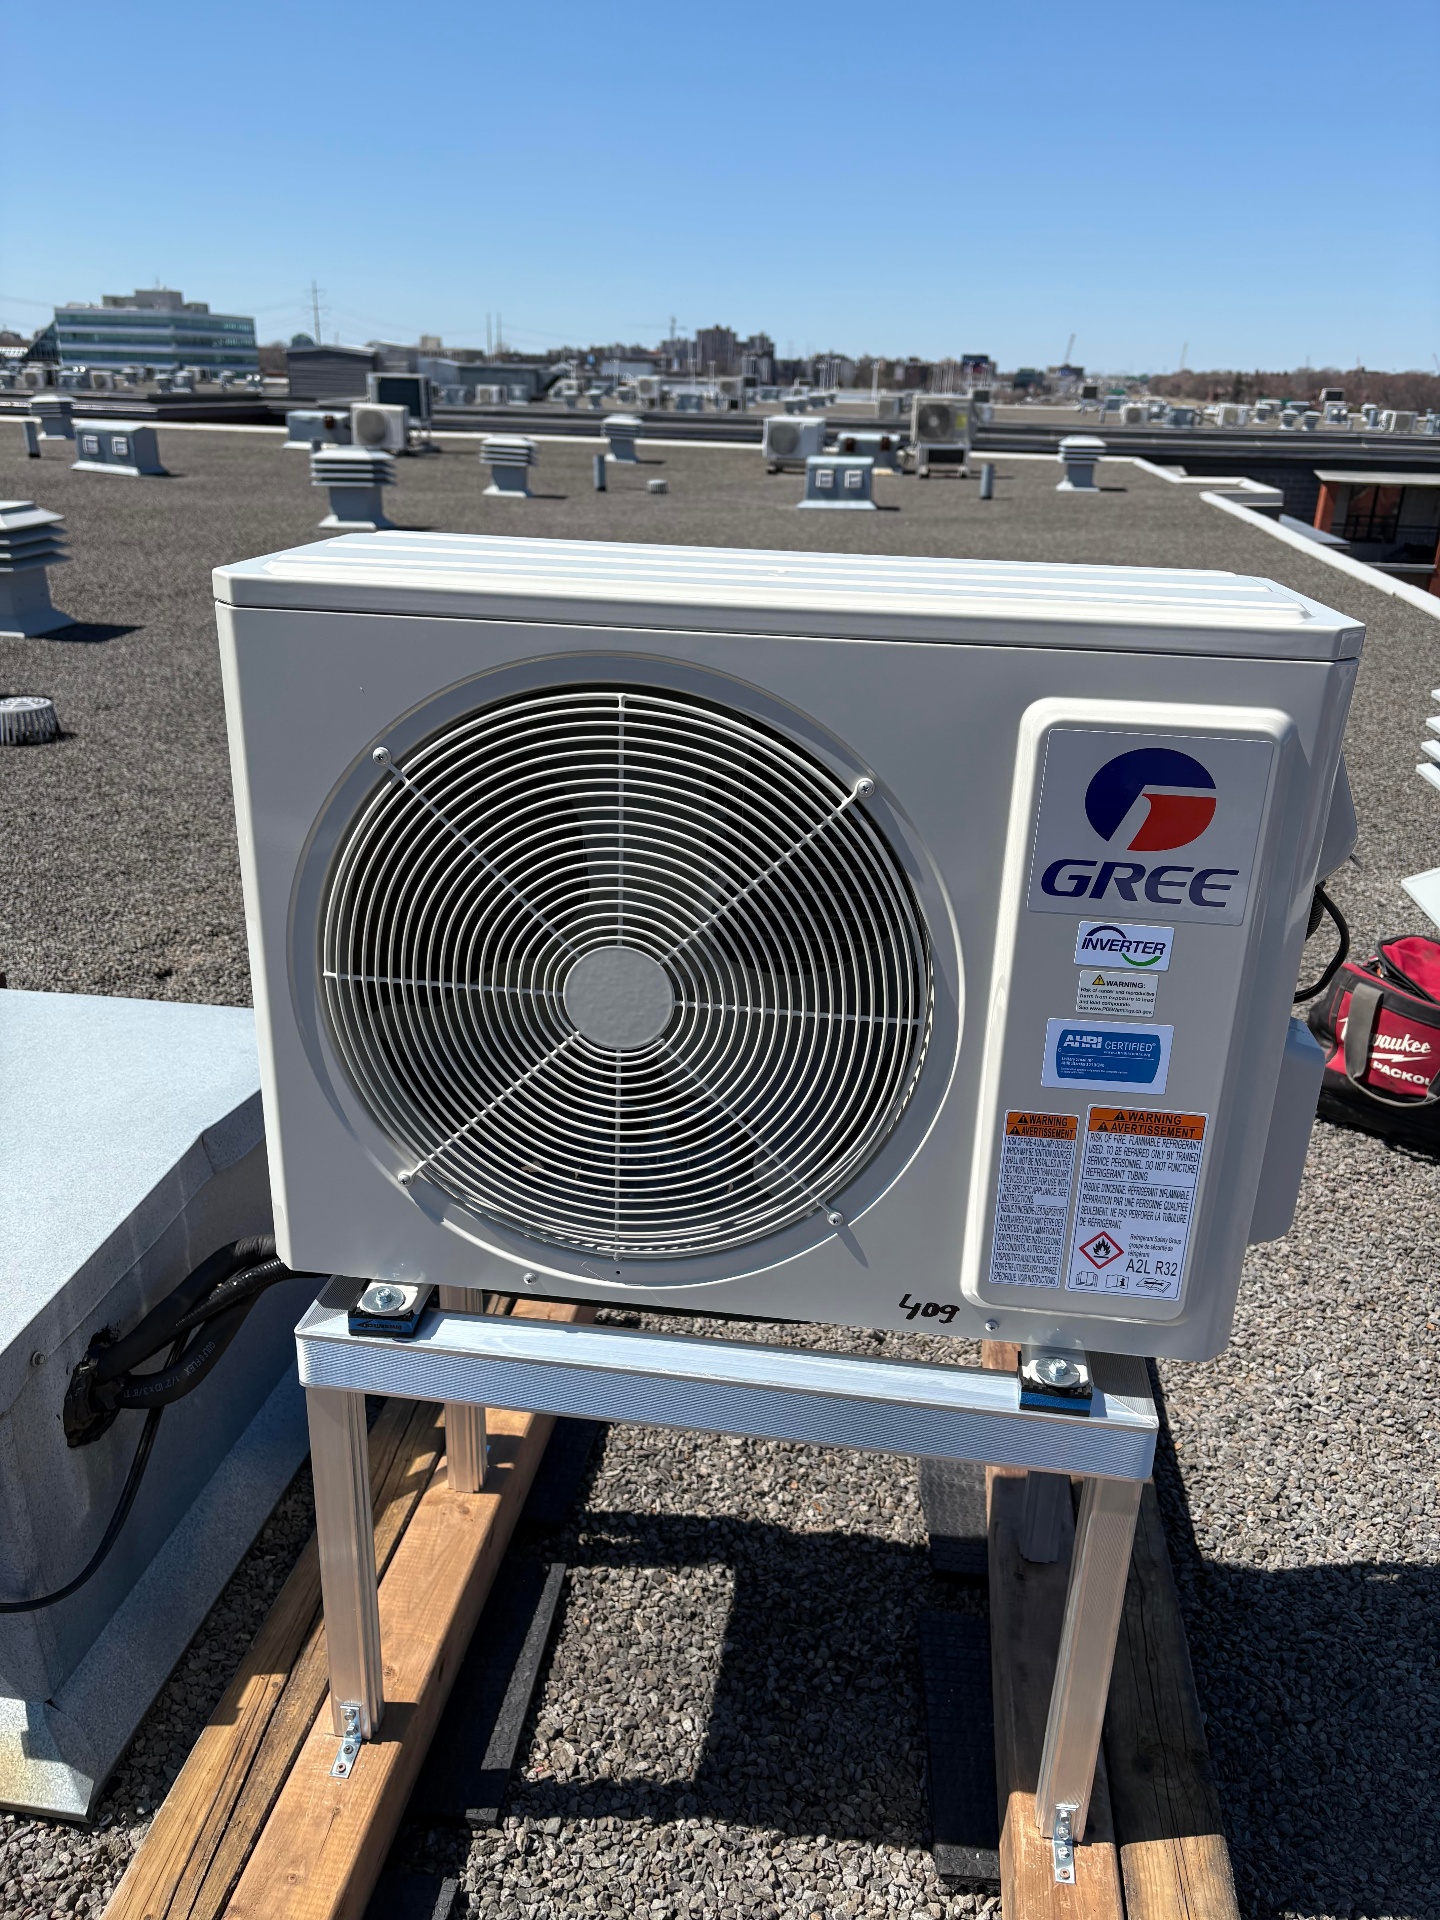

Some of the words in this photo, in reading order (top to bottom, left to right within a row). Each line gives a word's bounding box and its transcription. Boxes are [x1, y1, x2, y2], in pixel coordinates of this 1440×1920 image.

[1040, 859, 1240, 907] GREE
[1081, 936, 1166, 956] INVERTER
[1106, 980, 1146, 988] WARNING:
[1064, 1034, 1103, 1049] AHRI
[1372, 1061, 1431, 1086] PACKO
[1029, 1115, 1068, 1127] WARNING
[1128, 1112, 1182, 1125] WARNING
[1022, 1126, 1073, 1139] AVERTISSEMENT
[1111, 1122, 1195, 1138] AVERTISSEMENT
[1090, 1132, 1103, 1142] RISK
[1104, 1134, 1112, 1143] OF
[1129, 1136, 1161, 1147] FLAMMABLE
[1162, 1139, 1200, 1151] REFRIGERANT
[1106, 1146, 1114, 1155] TO
[1115, 1146, 1122, 1156] BE
[1124, 1147, 1150, 1158] REPAIRED
[1151, 1149, 1165, 1160] ONLY
[1166, 1151, 1174, 1160] BY
[1175, 1152, 1198, 1162] TRAINED
[1087, 1156, 1109, 1166] SERVICE
[1145, 1161, 1154, 1170] DO
[1155, 1162, 1166, 1171] NOT
[1167, 1163, 1197, 1174] PUNCTURE
[1086, 1167, 1125, 1179] REFRIGERANT
[1113, 1196, 1123, 1206] PAR
[1136, 1198, 1163, 1210] PERSONNE
[1079, 1217, 1087, 1226] DE
[1110, 1208, 1117, 1217] NE
[1118, 1209, 1128, 1218] PAS
[1129, 1210, 1154, 1220] PERFORER
[1155, 1212, 1162, 1221] LA
[1126, 1258, 1152, 1274] A2L
[1155, 1261, 1178, 1277] R32
[899, 1294, 960, 1323] 409
